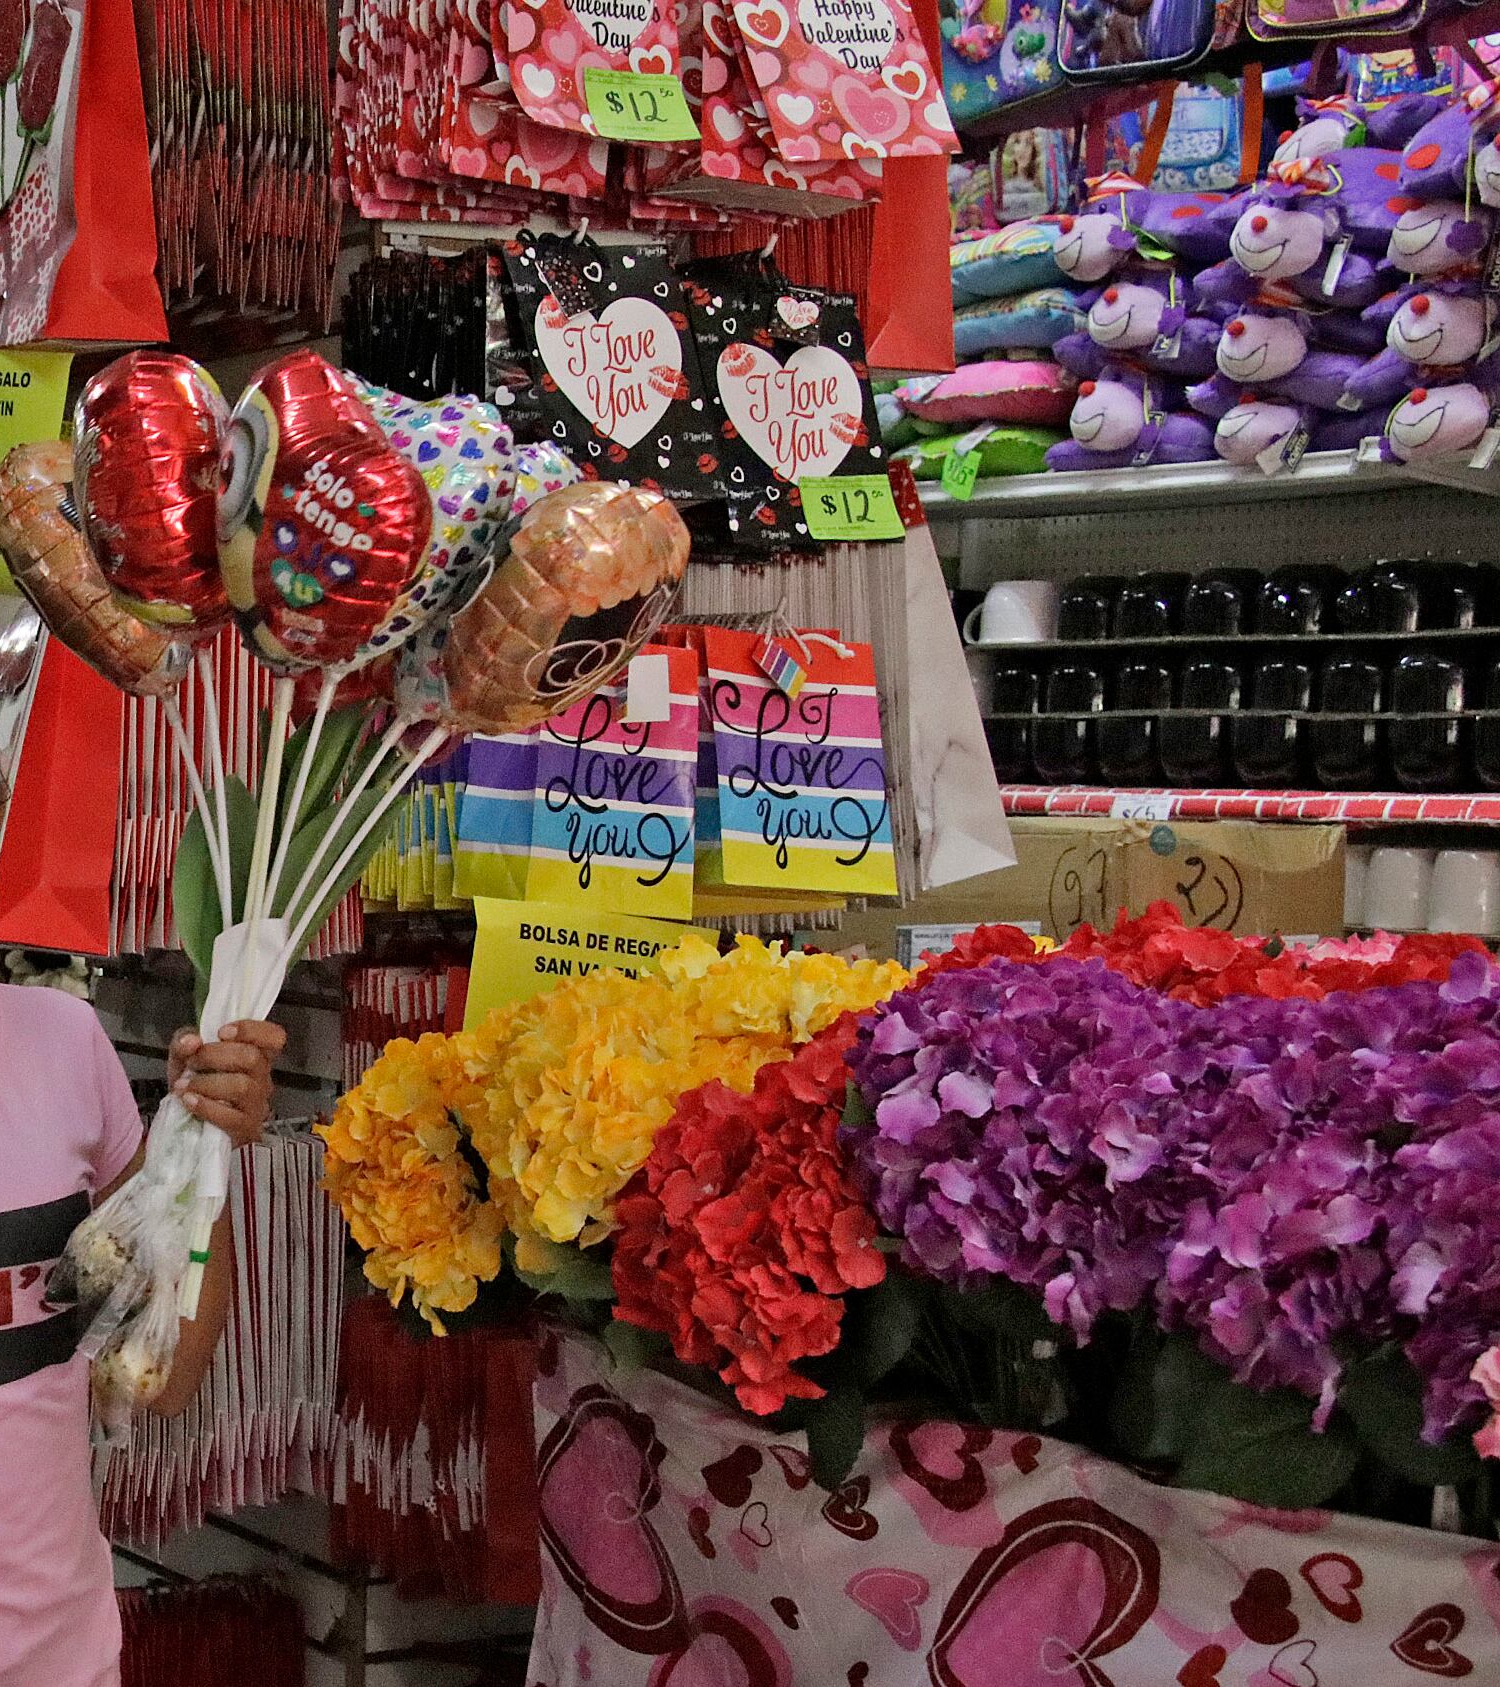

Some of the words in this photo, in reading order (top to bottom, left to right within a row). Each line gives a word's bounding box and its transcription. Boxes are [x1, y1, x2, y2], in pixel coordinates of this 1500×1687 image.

[815, 0, 876, 21] Happy
[592, 21, 632, 56] Day
[800, 20, 905, 44] Valentine's
[838, 47, 883, 75] Day
[590, 319, 656, 373] Love
[586, 374, 649, 438] You
[775, 367, 838, 420] Love
[767, 419, 829, 481] You
[304, 461, 355, 509] Solo
[295, 489, 373, 551] tengo
[519, 922, 580, 948] BOLSA
[586, 932, 609, 951] DE
[615, 937, 680, 958] REGA
[534, 955, 572, 976] SAN
